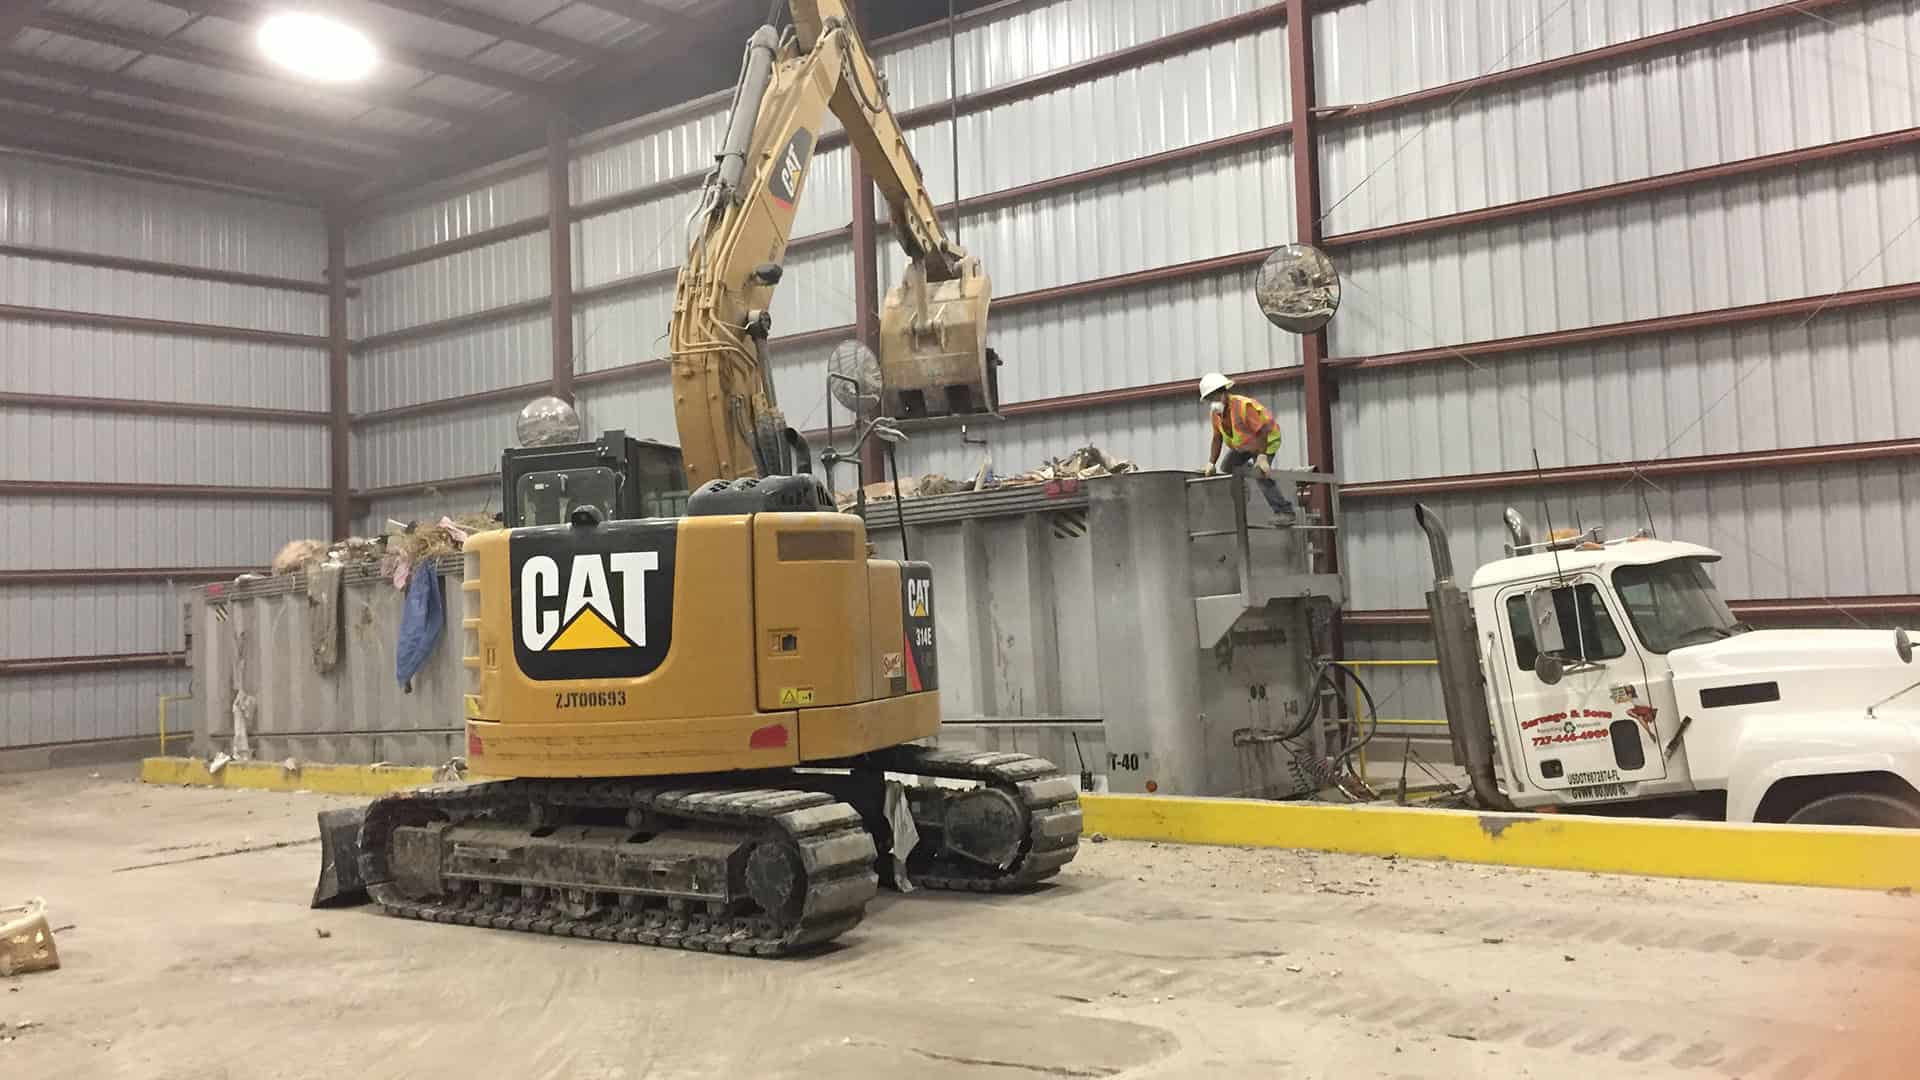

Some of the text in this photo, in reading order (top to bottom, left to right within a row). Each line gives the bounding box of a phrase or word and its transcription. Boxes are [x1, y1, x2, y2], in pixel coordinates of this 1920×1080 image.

[781, 143, 802, 197] CAT
[521, 552, 658, 651] CAT
[908, 578, 930, 616] CAT
[916, 627, 932, 646] 314E
[1570, 709, 1580, 719] &
[1583, 709, 1612, 719] Sons
[1110, 753, 1138, 771] T-40
